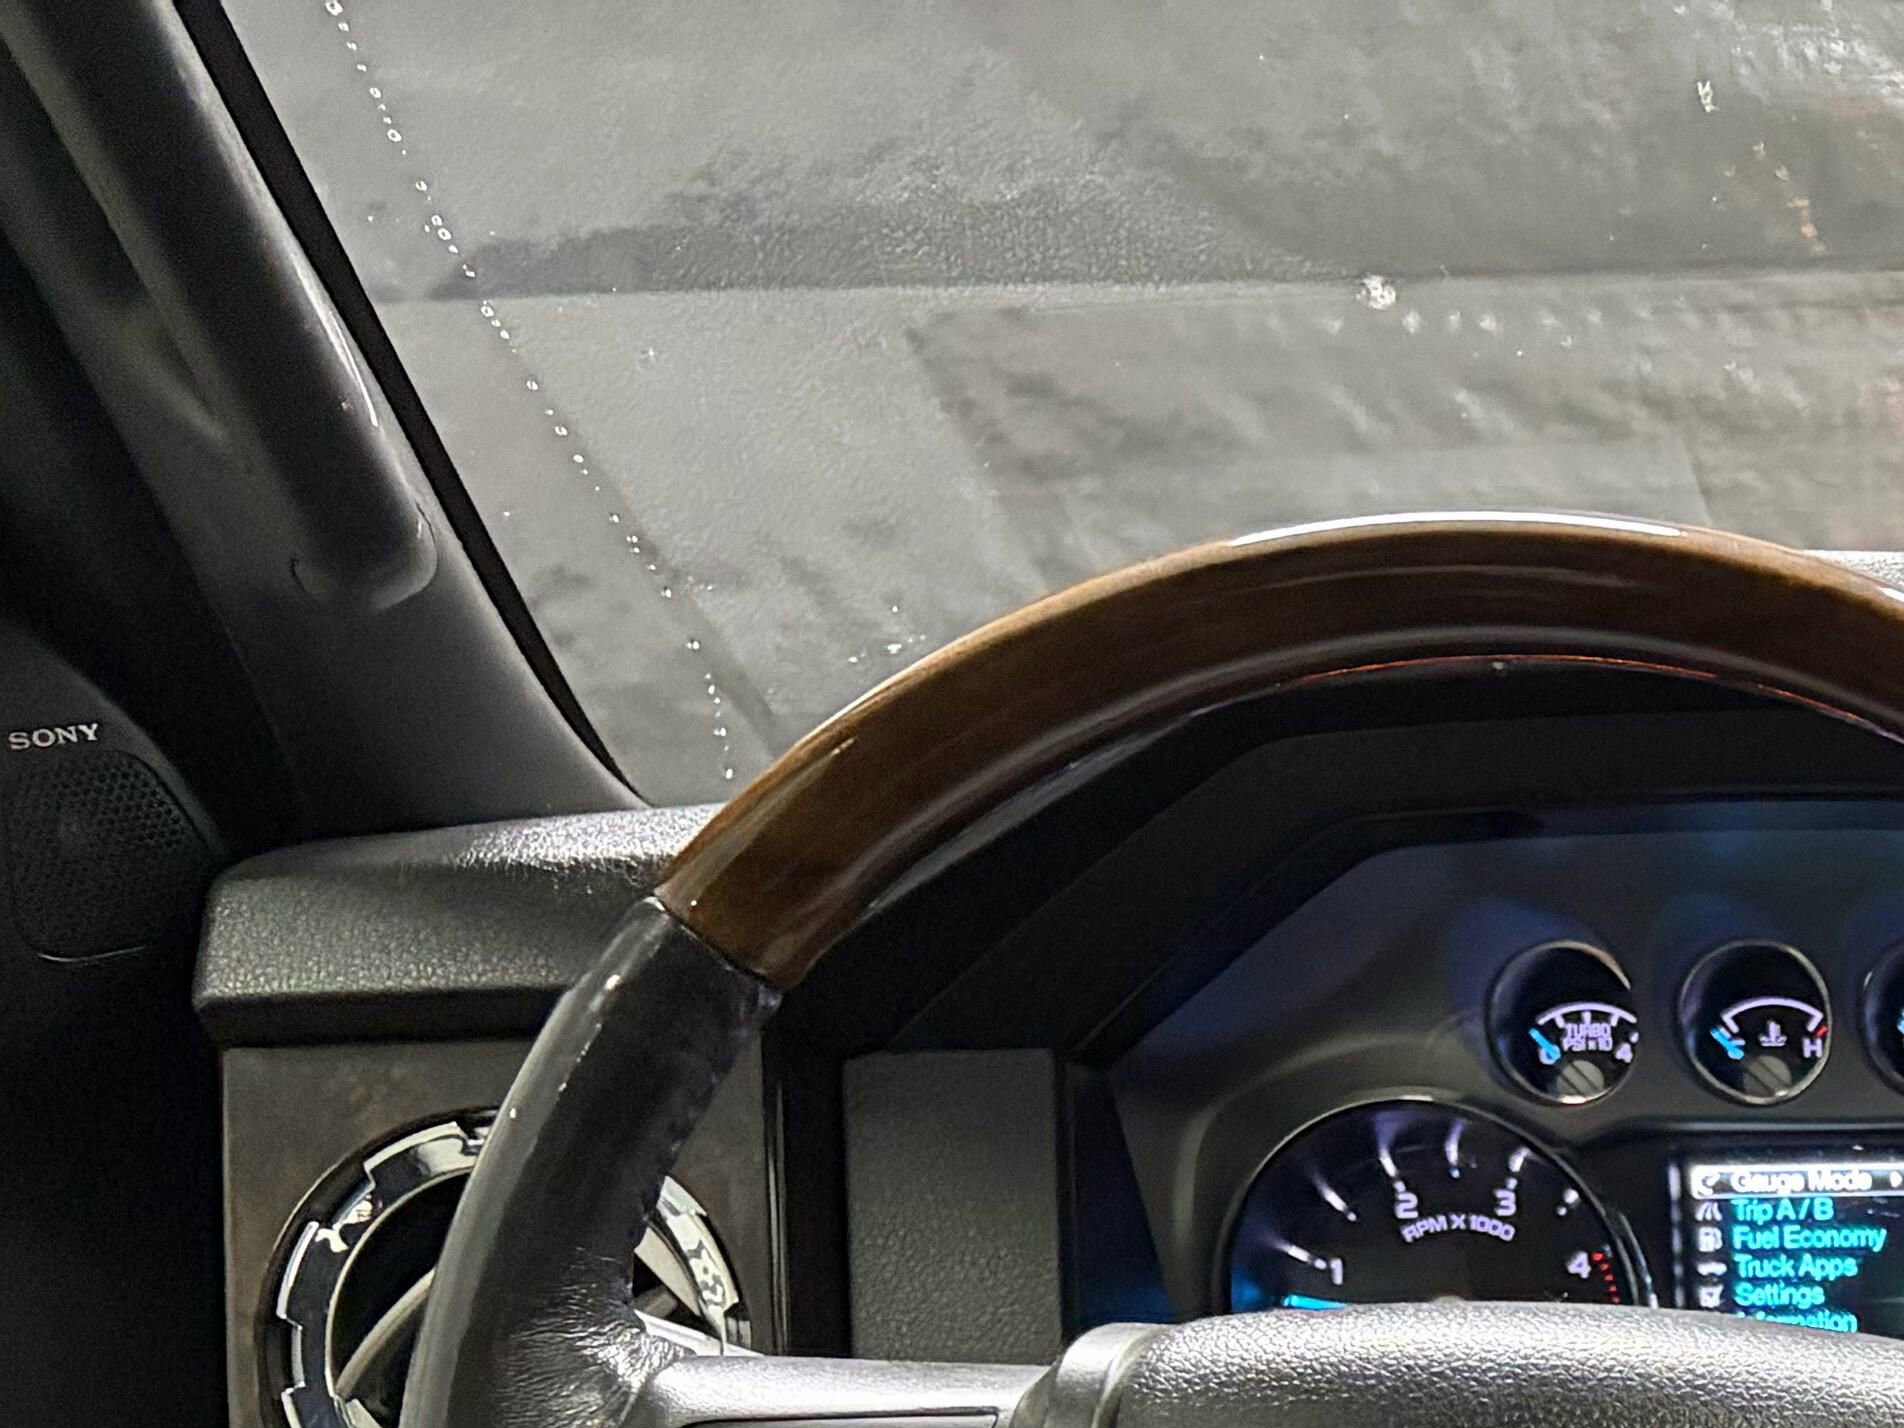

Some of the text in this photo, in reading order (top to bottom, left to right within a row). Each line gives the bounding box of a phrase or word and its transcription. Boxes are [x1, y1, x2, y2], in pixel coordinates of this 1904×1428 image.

[8, 722, 99, 750] SONY
[1564, 1022, 1612, 1038] TURBO
[1562, 1037, 1586, 1052] PSI
[1598, 1038, 1613, 1052] 10
[1615, 1042, 1633, 1063] 4
[1802, 1037, 1824, 1059] H
[1730, 1169, 1873, 1194] Gauge Mode
[1395, 1191, 1418, 1219] 2
[1494, 1188, 1517, 1217] 3
[1733, 1200, 1772, 1225] Trip
[1776, 1200, 1797, 1221] A
[1813, 1197, 1834, 1220] B
[1401, 1214, 1448, 1242] RPM
[1468, 1214, 1516, 1242] 1000
[1732, 1227, 1888, 1253] Fuel Economy
[1330, 1256, 1345, 1286] 1
[1567, 1250, 1592, 1279] 4
[1734, 1254, 1858, 1281] Truck Apps
[1733, 1282, 1826, 1309] Settings
